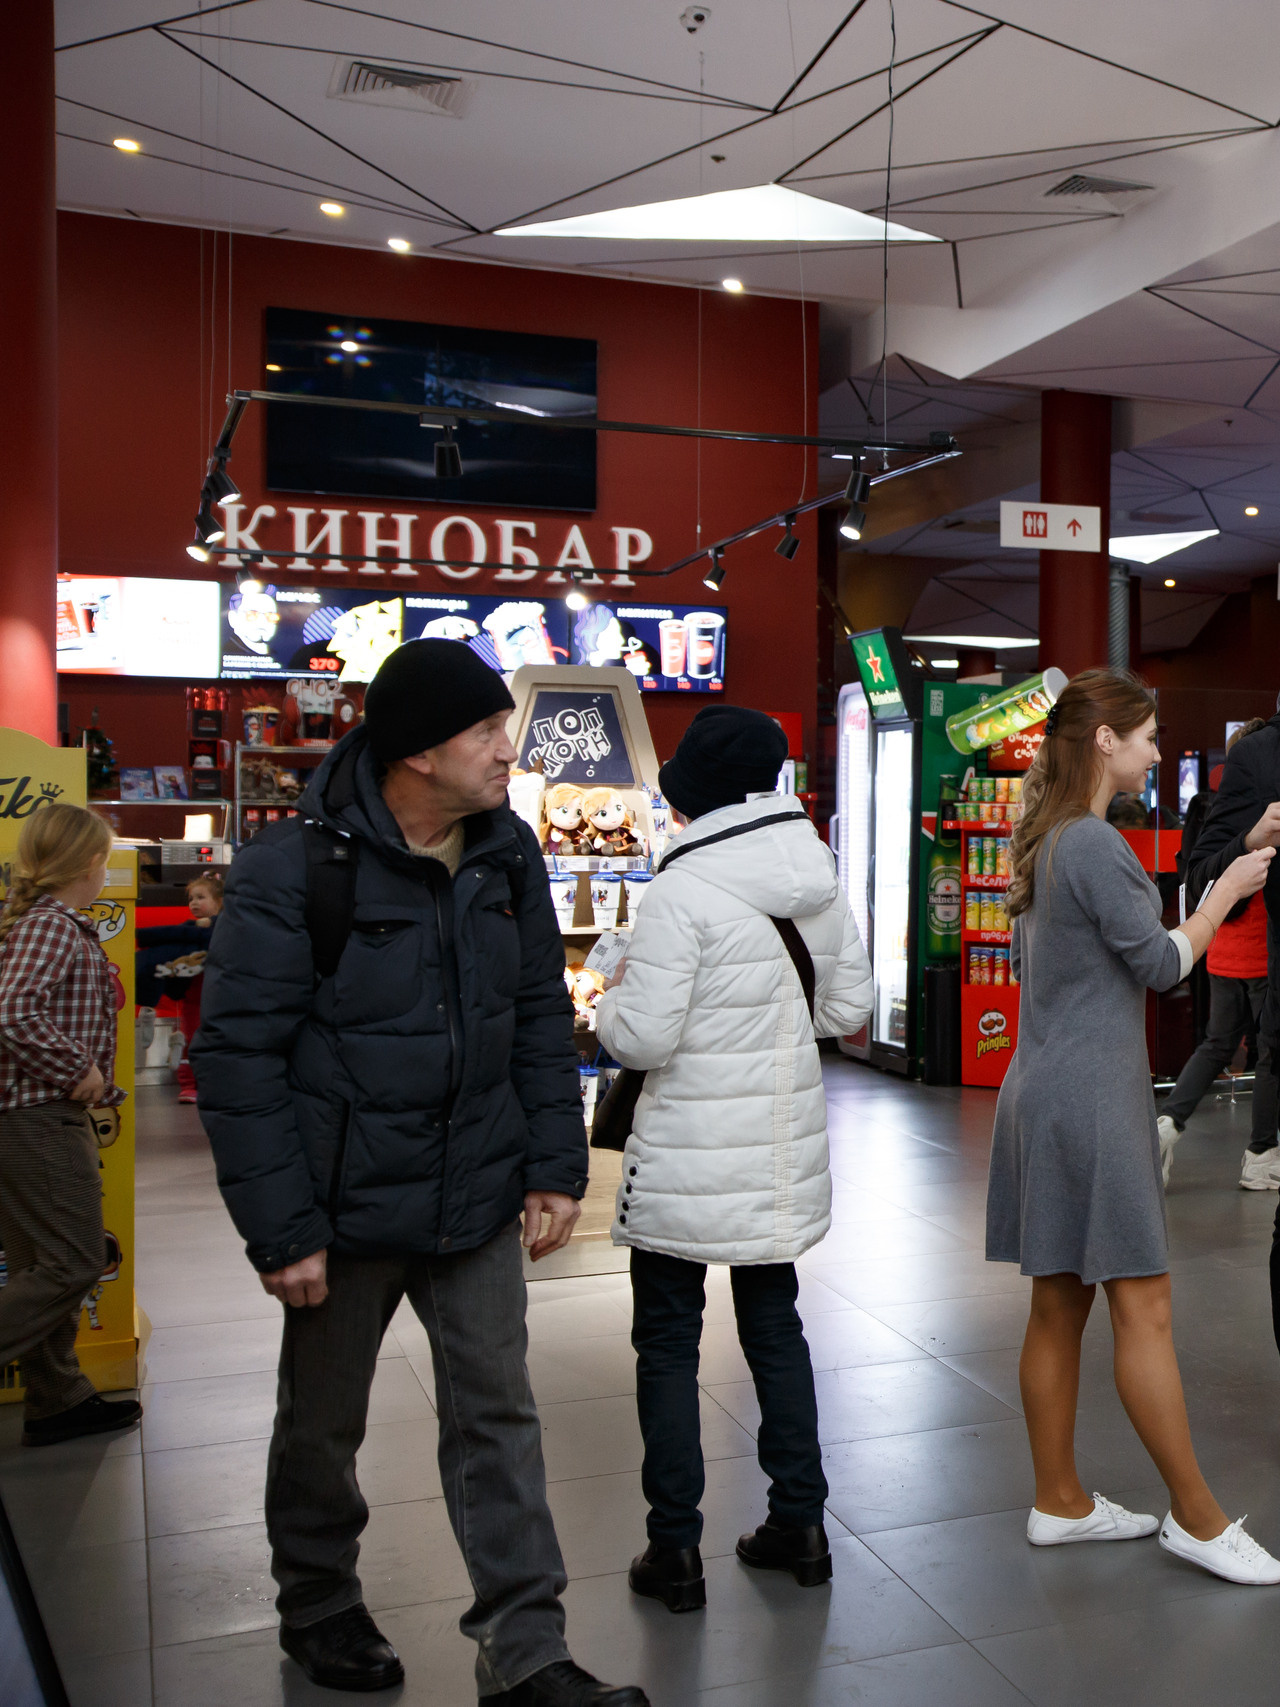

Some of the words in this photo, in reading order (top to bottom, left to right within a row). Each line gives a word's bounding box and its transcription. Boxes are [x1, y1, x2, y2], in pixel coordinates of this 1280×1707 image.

[218, 503, 653, 587] КИНОБАР
[309, 657, 340, 671] 370
[868, 687, 902, 706] Heineken
[531, 707, 604, 745] ПОП
[929, 894, 961, 904] Heineke
[977, 1033, 1011, 1058] Pringles
